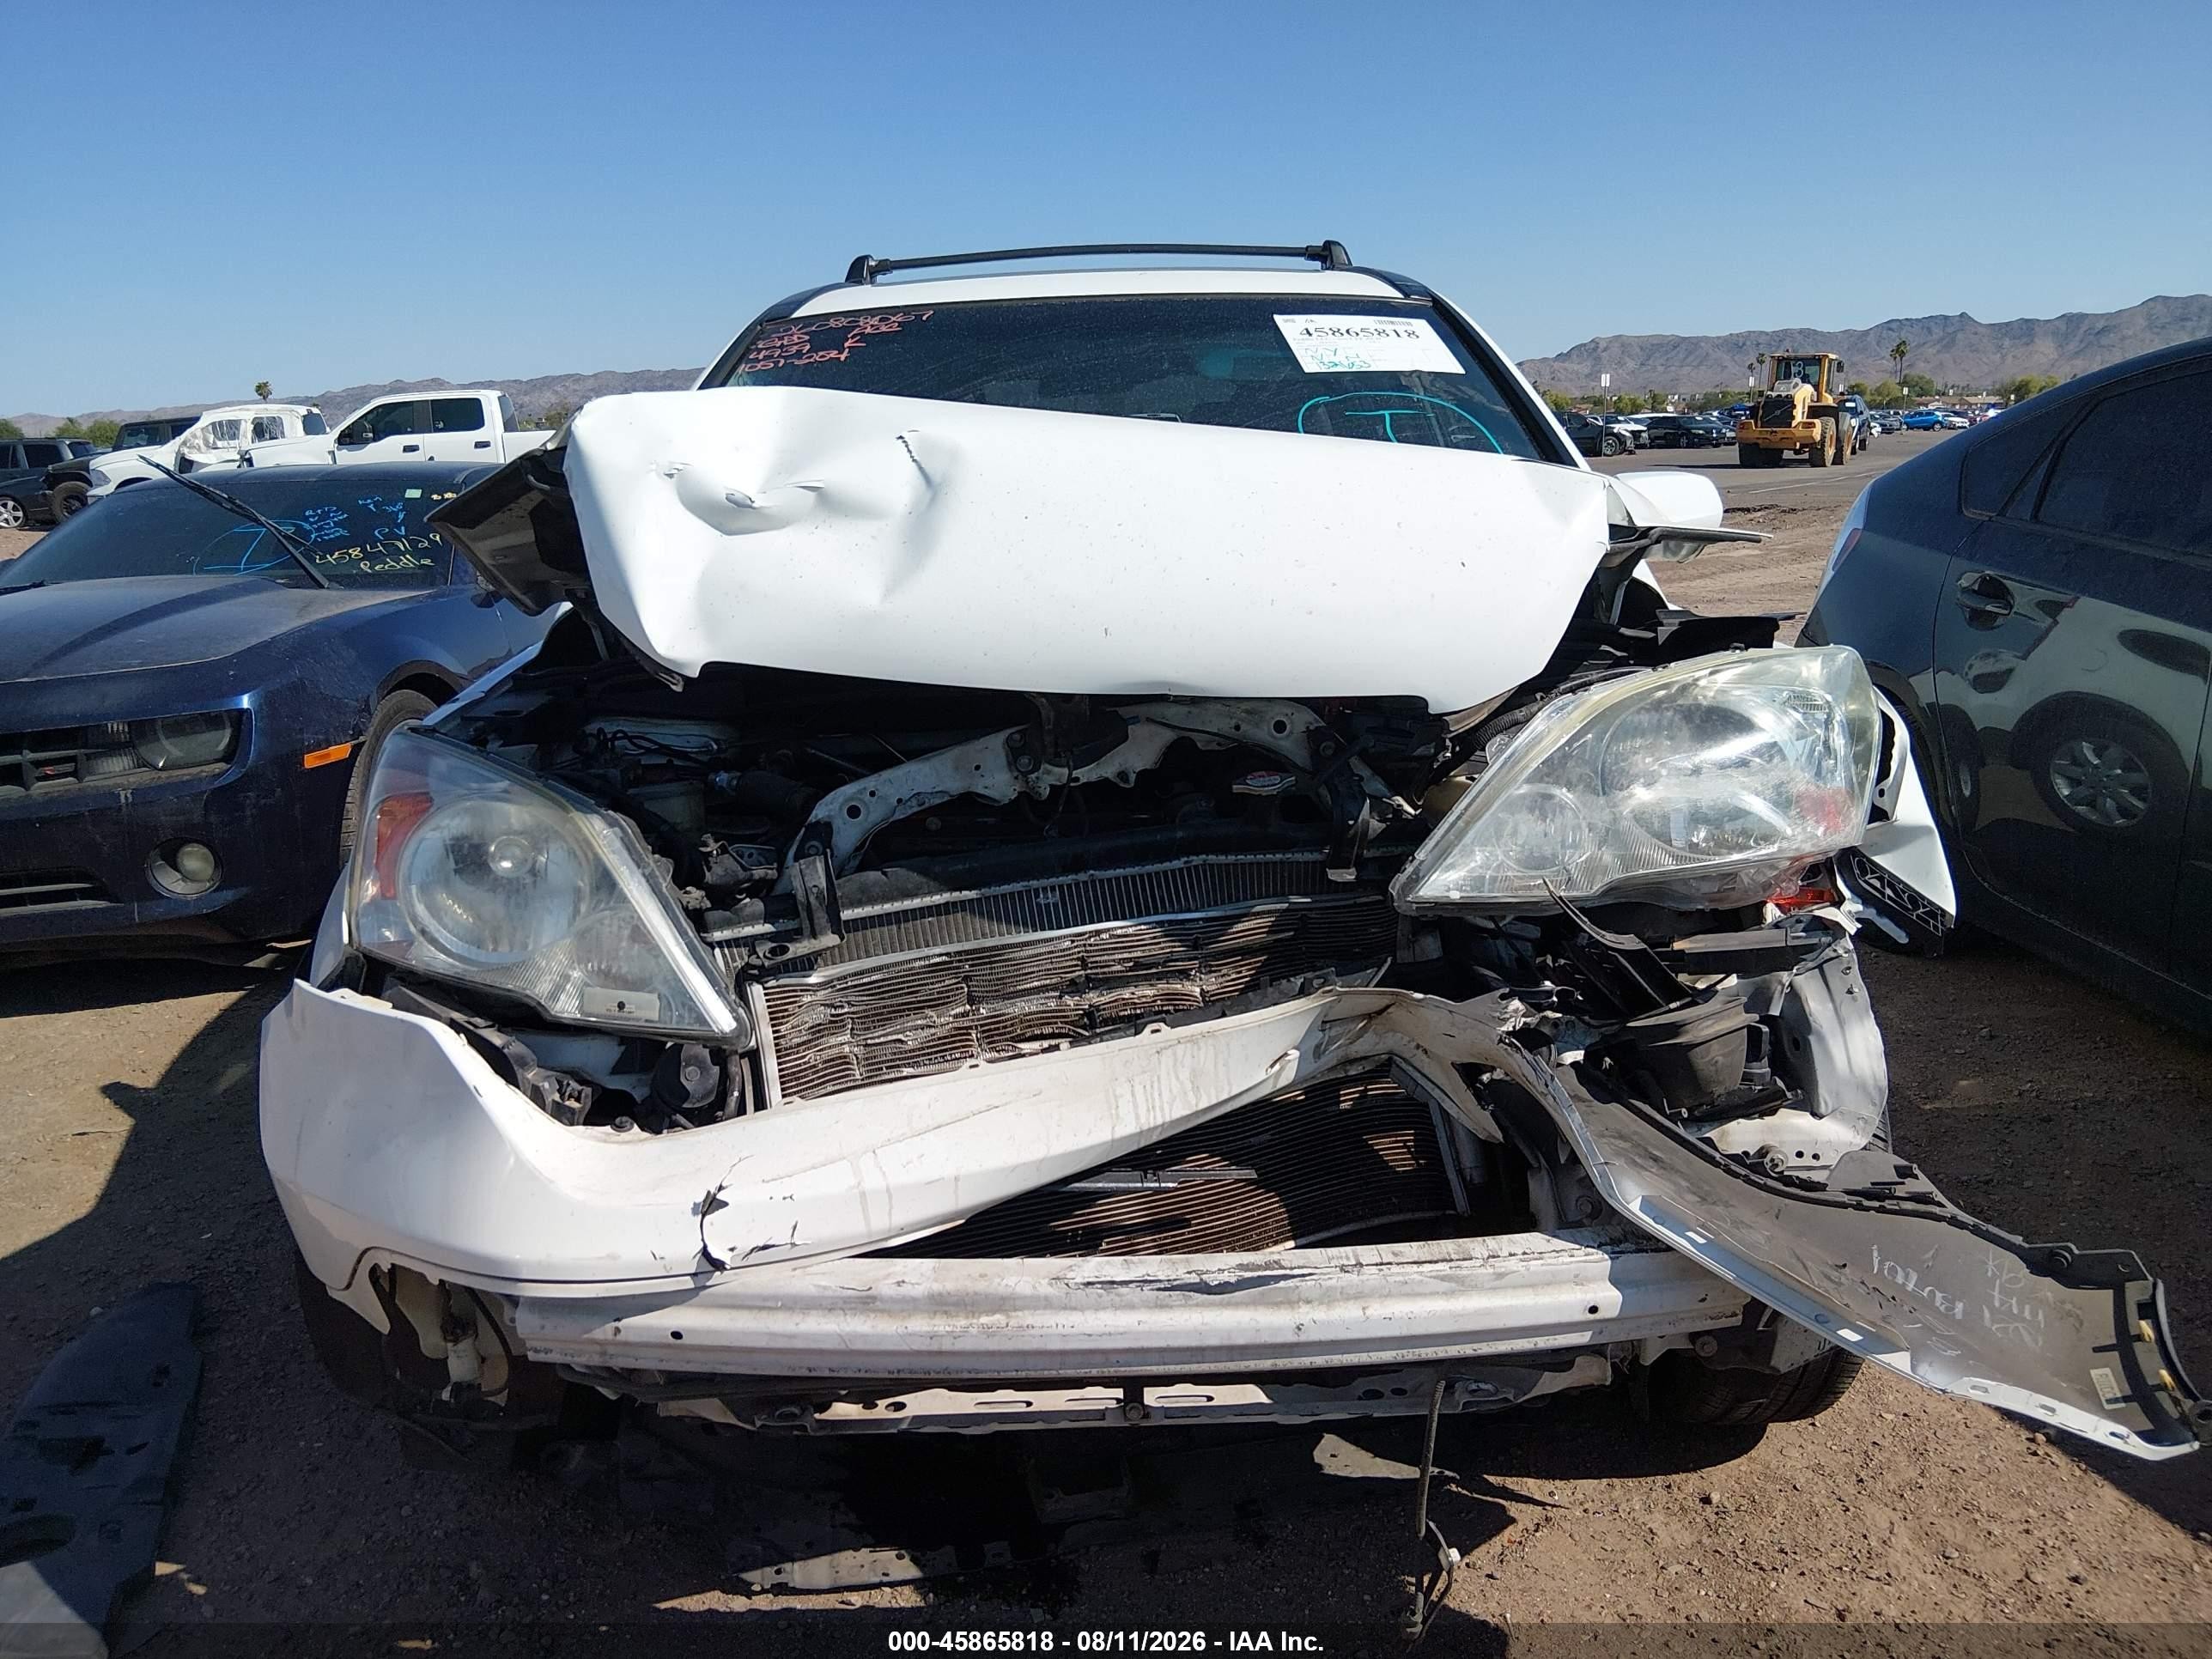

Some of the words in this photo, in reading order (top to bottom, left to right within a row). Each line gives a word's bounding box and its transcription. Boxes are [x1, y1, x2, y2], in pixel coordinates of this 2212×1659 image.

[1298, 326, 1420, 339] 45865818
[749, 343, 811, 360] 4939
[315, 532, 443, 565] 45847129
[360, 553, 435, 574] Peddle
